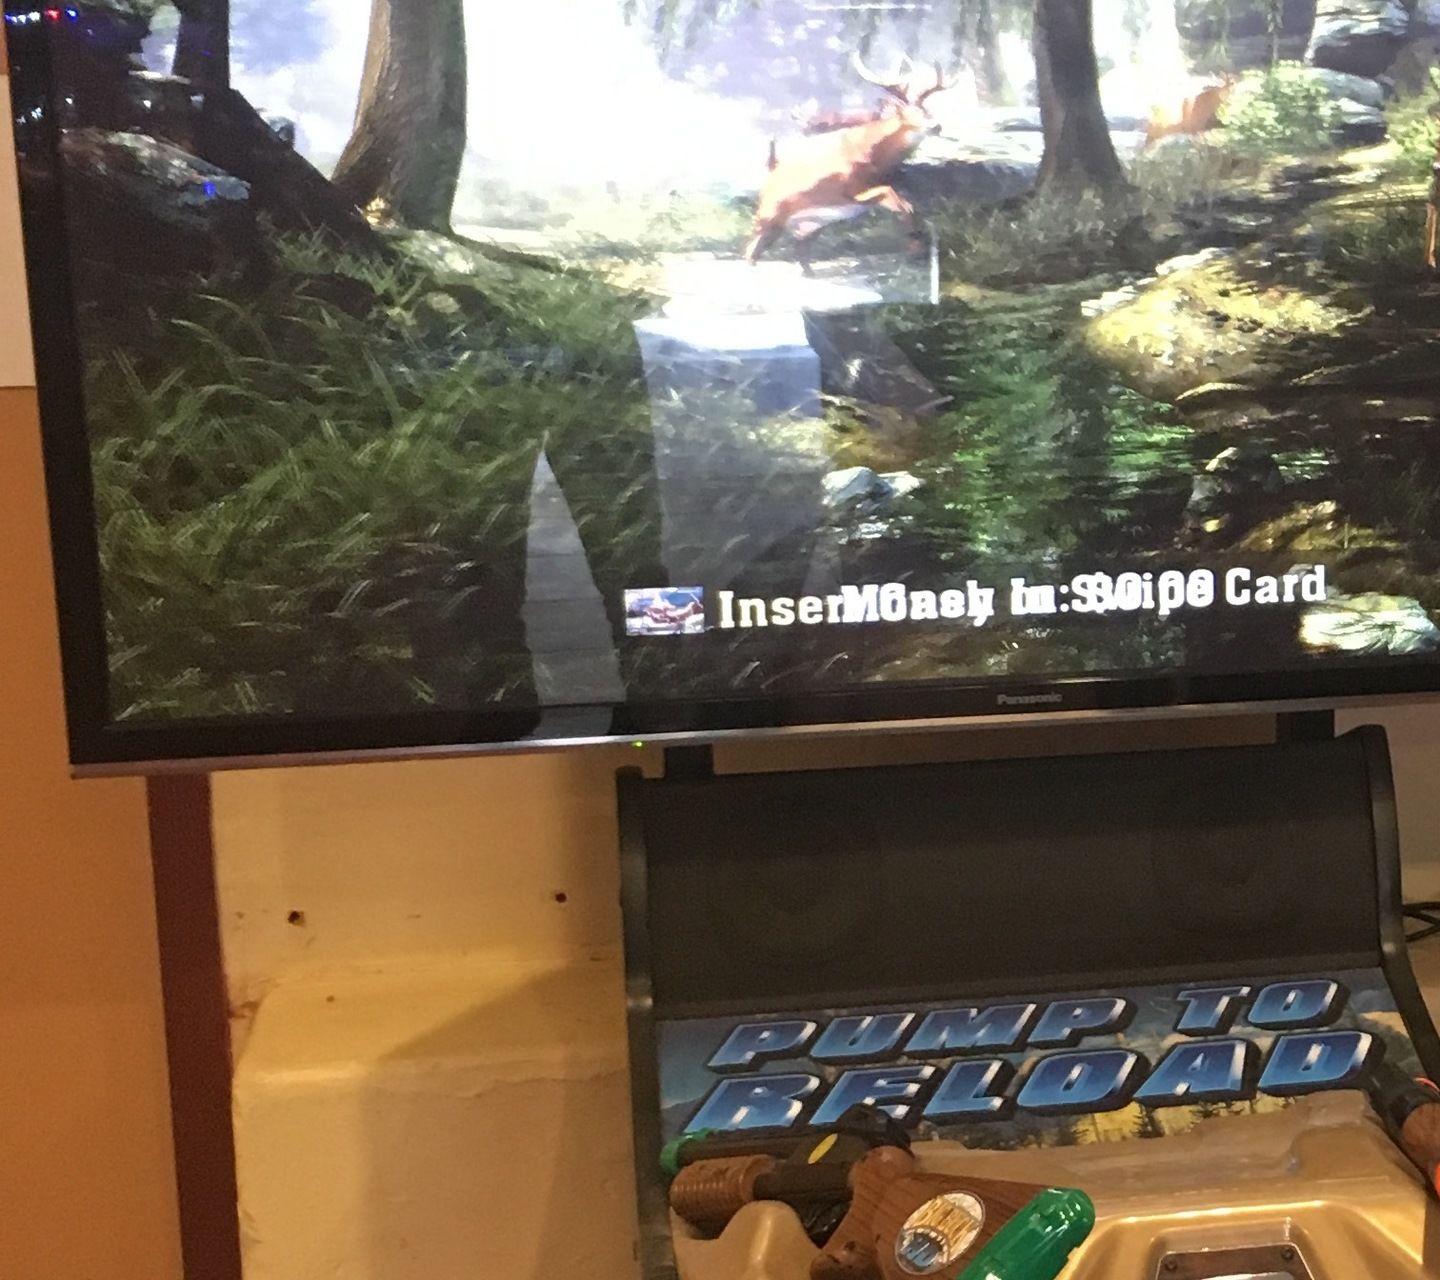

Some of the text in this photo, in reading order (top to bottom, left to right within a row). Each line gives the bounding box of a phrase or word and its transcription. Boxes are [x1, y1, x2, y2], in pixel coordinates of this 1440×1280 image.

[1225, 564, 1328, 606] Card
[997, 693, 1063, 706] Panasonic
[707, 978, 1341, 1069] PUMP TO
[684, 1029, 1374, 1134] RELOAD
